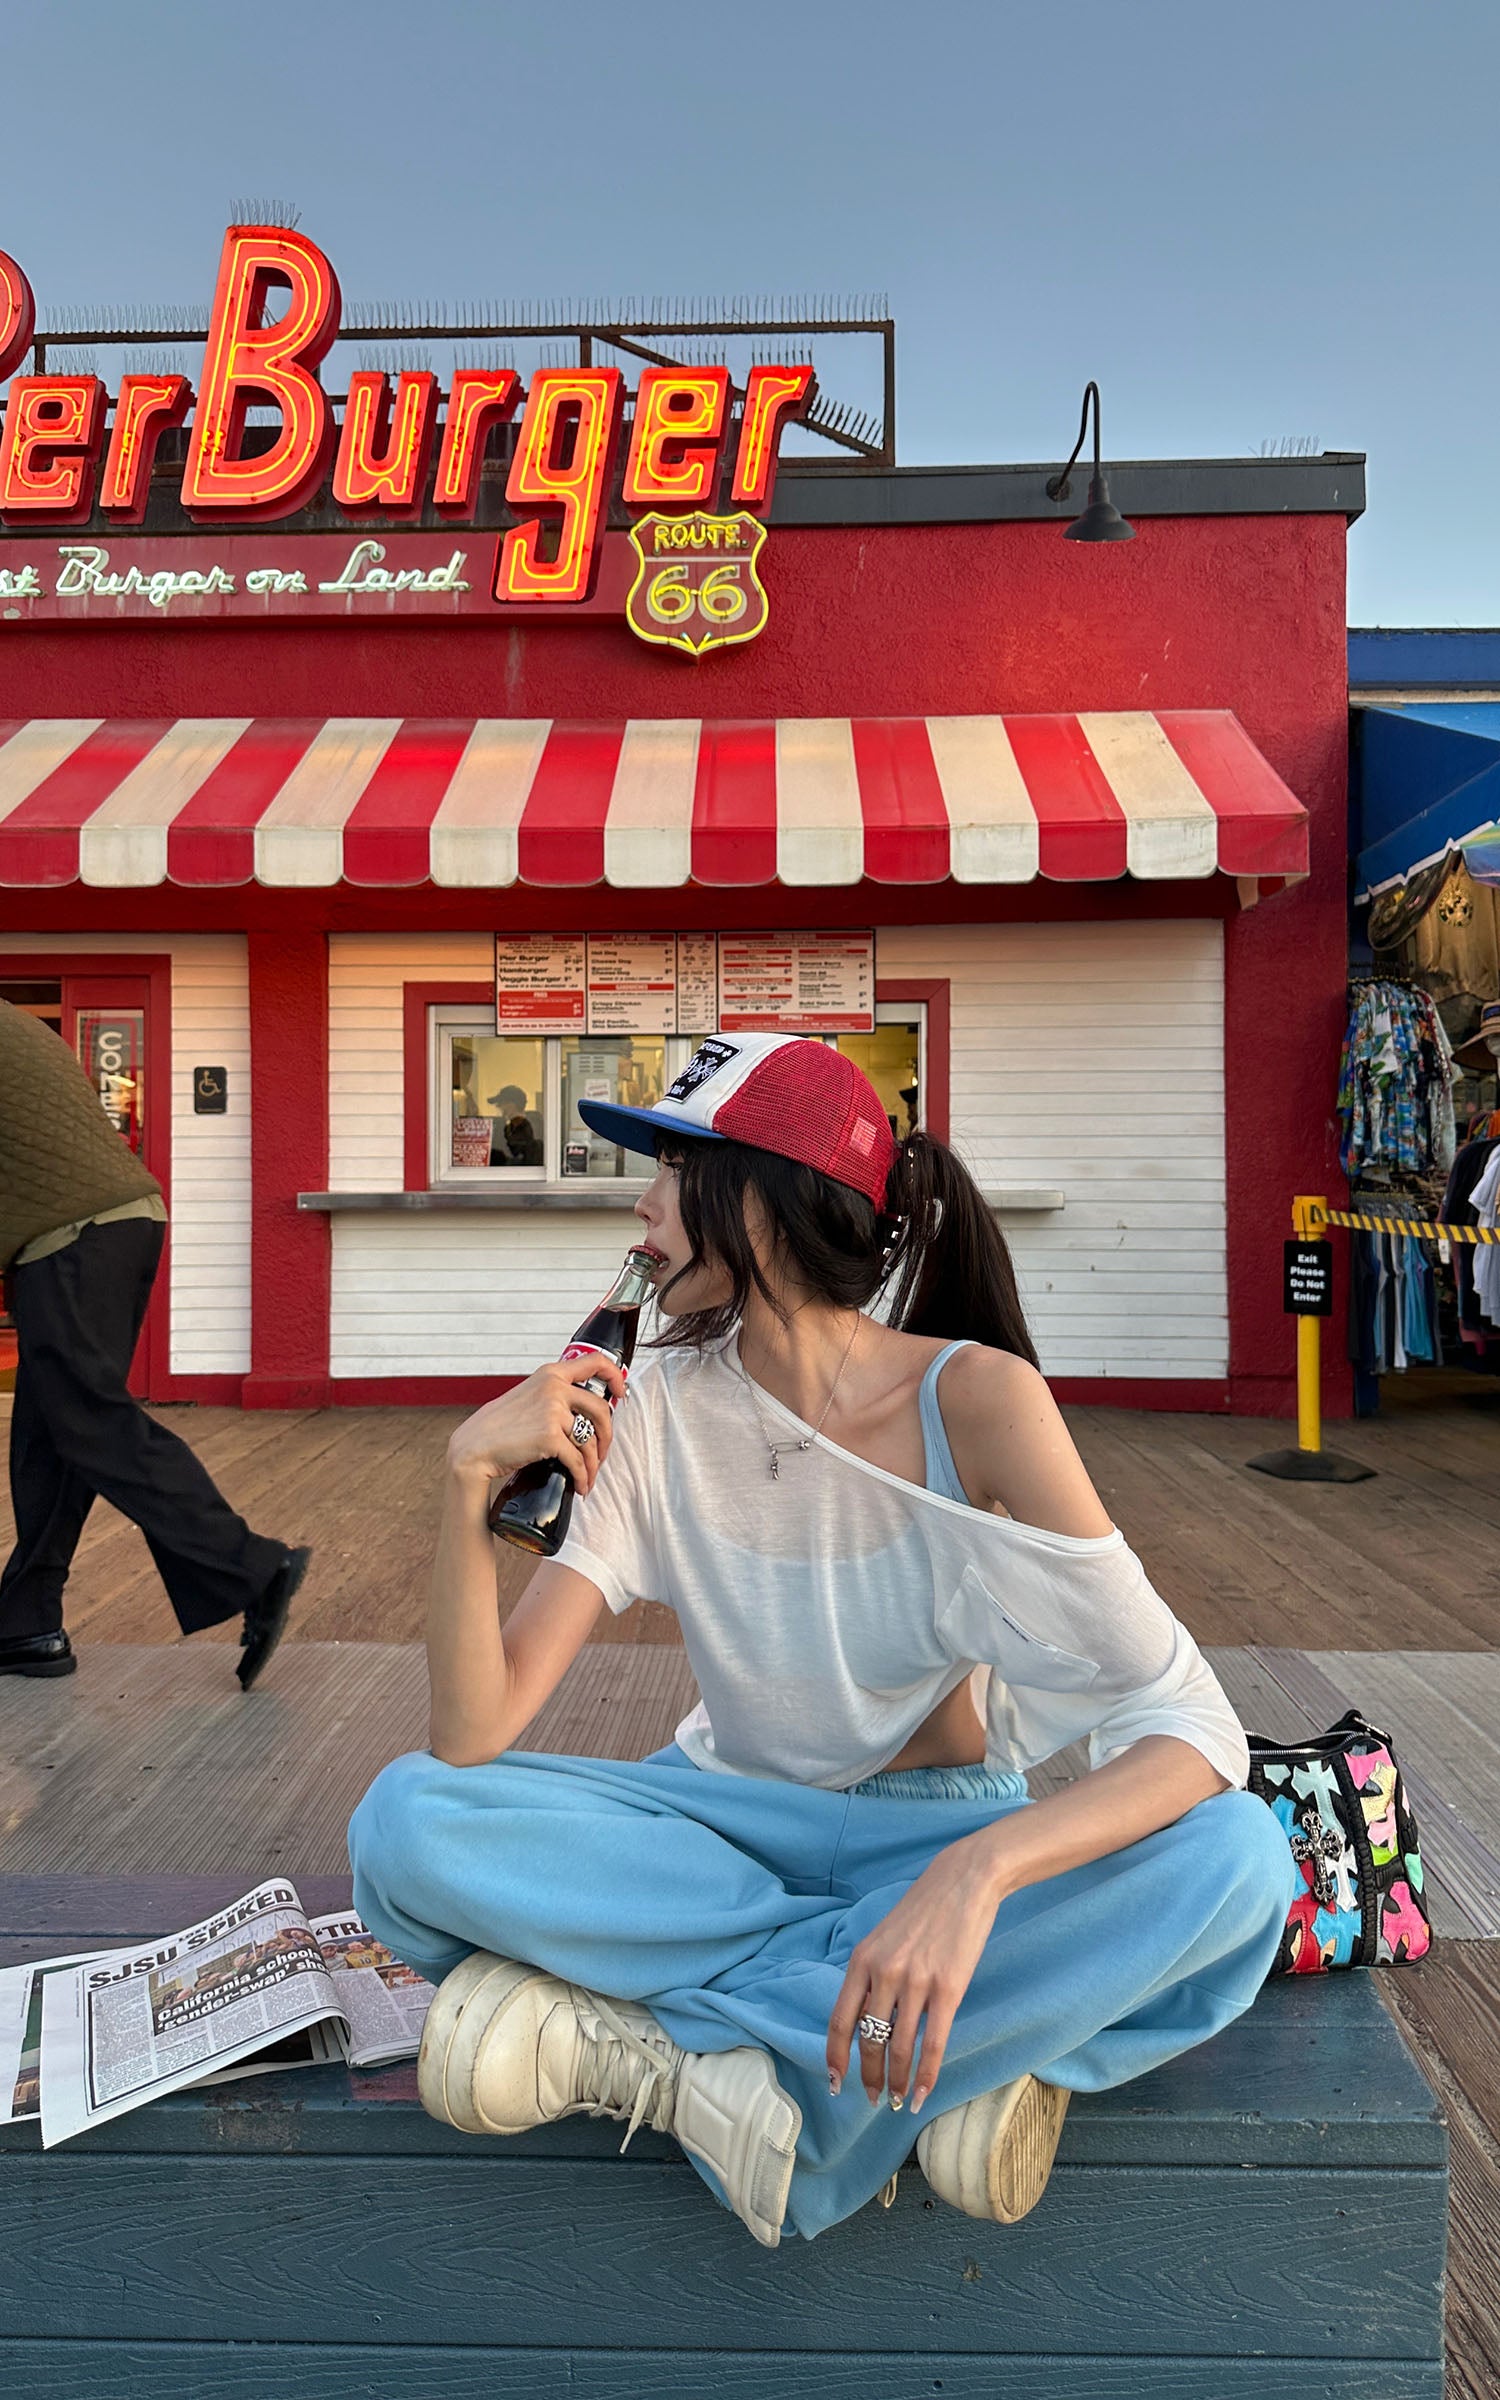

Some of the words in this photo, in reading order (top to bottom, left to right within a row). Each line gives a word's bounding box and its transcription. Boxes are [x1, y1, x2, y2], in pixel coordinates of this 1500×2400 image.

[179, 224, 815, 603] Burger
[654, 523, 740, 549] ROUTE
[56, 546, 237, 607] Burger
[246, 569, 308, 594] on
[318, 540, 473, 592] Land
[646, 565, 747, 624] 66
[1290, 1266, 1325, 1277] Please
[1297, 1254, 1318, 1263] Exit
[1290, 1278, 1305, 1288] Do
[1306, 1279, 1325, 1289] Not
[1293, 1292, 1321, 1302] Enter
[89, 1946, 178, 1989] SJSU
[187, 1889, 294, 1951] SPIKED
[157, 1973, 252, 2024] California
[255, 1948, 323, 1975] schools
